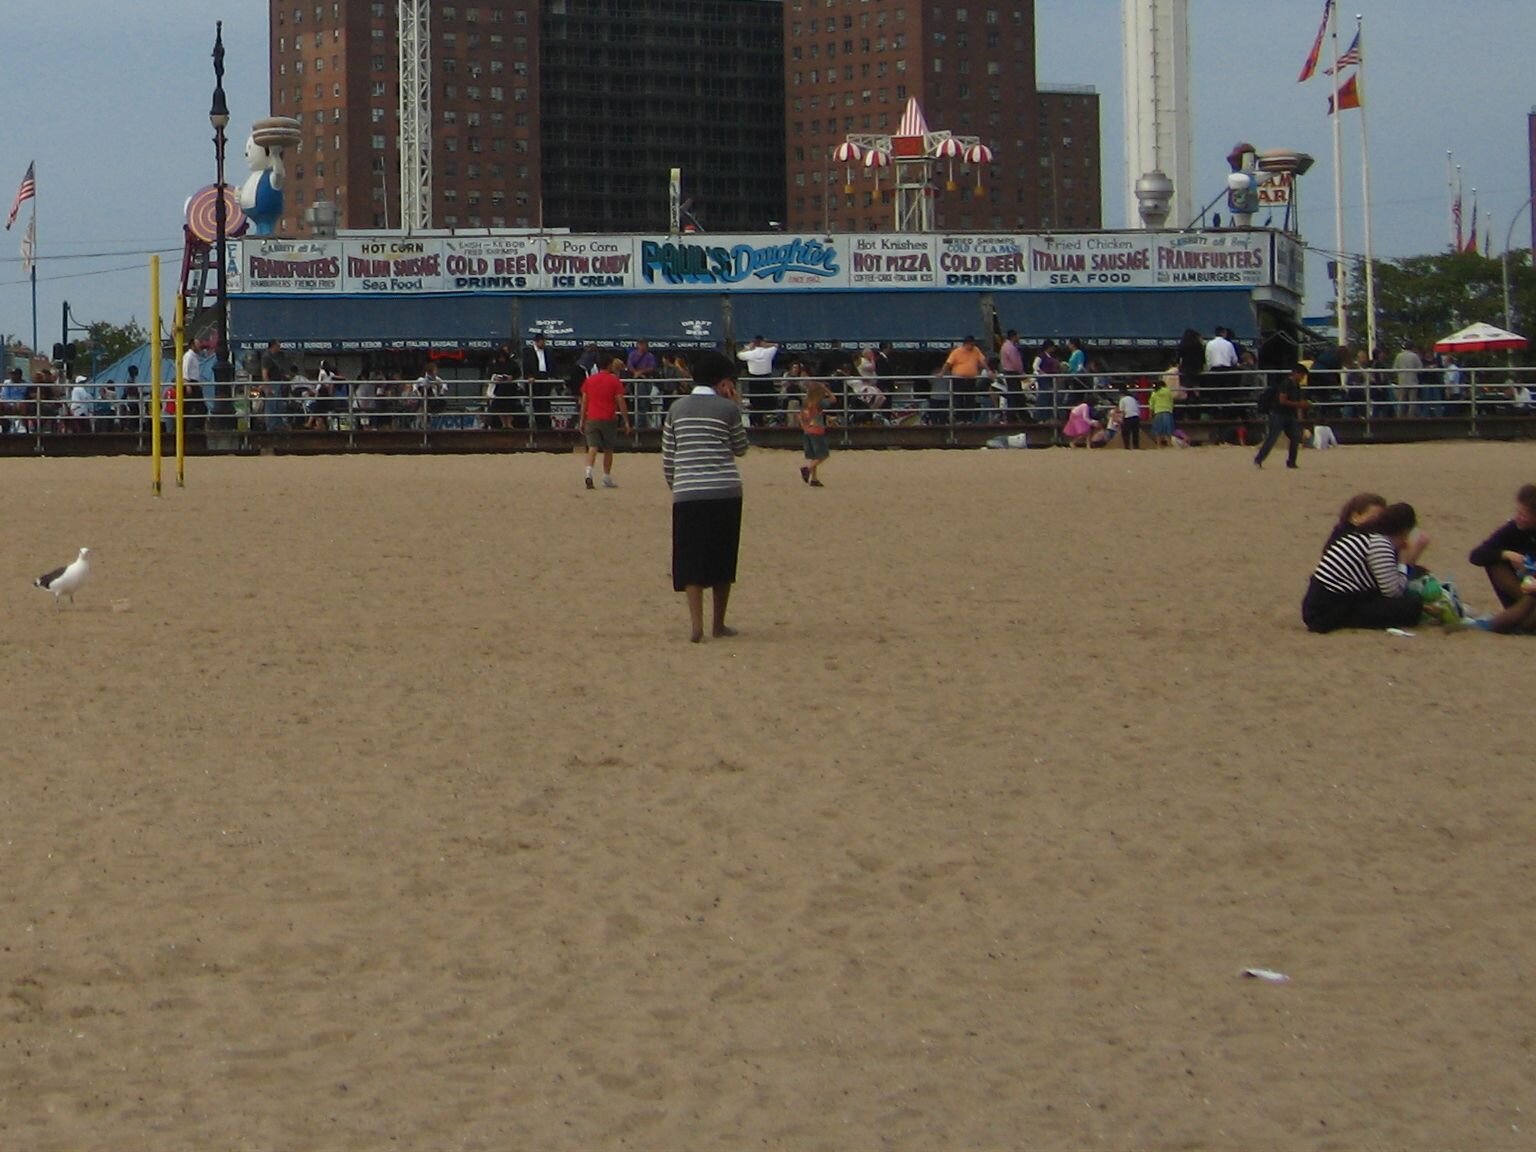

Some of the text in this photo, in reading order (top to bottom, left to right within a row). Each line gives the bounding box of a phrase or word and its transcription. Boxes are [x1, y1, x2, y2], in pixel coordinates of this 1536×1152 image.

[858, 239, 928, 250] Hot Knishes
[977, 237, 1016, 245] SHRIMPS
[1047, 238, 1132, 249] Fried Chicken
[362, 243, 424, 253] HOT CORN
[564, 241, 617, 254] Pop Corn
[975, 244, 1019, 253] CLAMS
[447, 253, 538, 275] COLD BEER
[543, 253, 631, 274] COTTON CANDY
[642, 238, 840, 284] PAUL'S Daughter
[853, 252, 931, 272] HOT PIZZA
[940, 252, 1025, 272] COLD BEER
[1033, 248, 1150, 272] ITALIAN SAUSAGE
[1158, 247, 1263, 269] FRANKFURTERS
[250, 255, 340, 278] FRANKFURTERS
[348, 253, 441, 277] ITALIAN SAUSAGE
[456, 276, 526, 288] DRINKS
[553, 276, 624, 287] ICE CREAM
[946, 274, 1017, 285] DRINKS
[1050, 273, 1131, 284] SEA FOOD
[1173, 272, 1241, 282] HAMBURGERS
[251, 279, 290, 288] HAMBURGERS
[295, 279, 316, 288] FRENCH
[319, 279, 335, 288] FRIES
[362, 278, 423, 290] Sea Food
